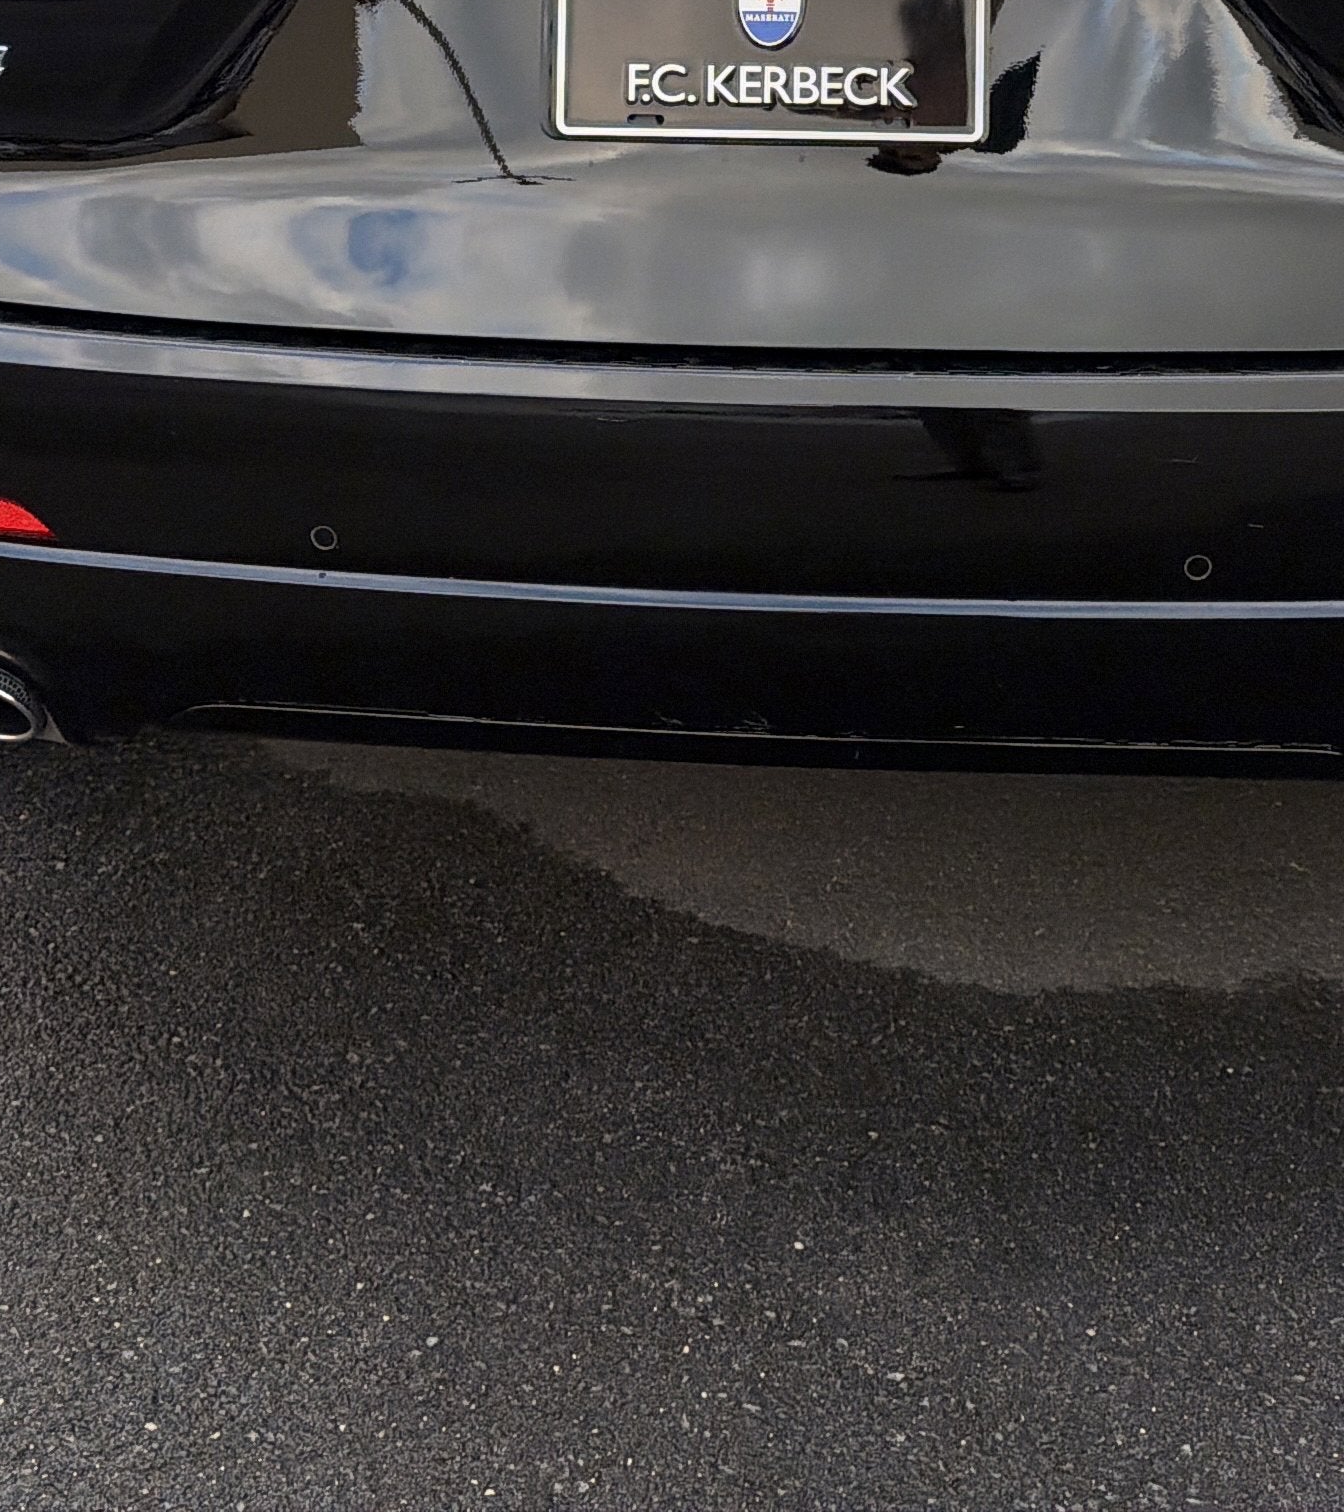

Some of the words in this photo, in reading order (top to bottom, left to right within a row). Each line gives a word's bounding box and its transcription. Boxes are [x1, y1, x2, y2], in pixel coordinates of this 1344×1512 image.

[745, 13, 795, 23] MASERATI
[627, 63, 698, 104] F.C.
[708, 64, 914, 107] KERBECK
